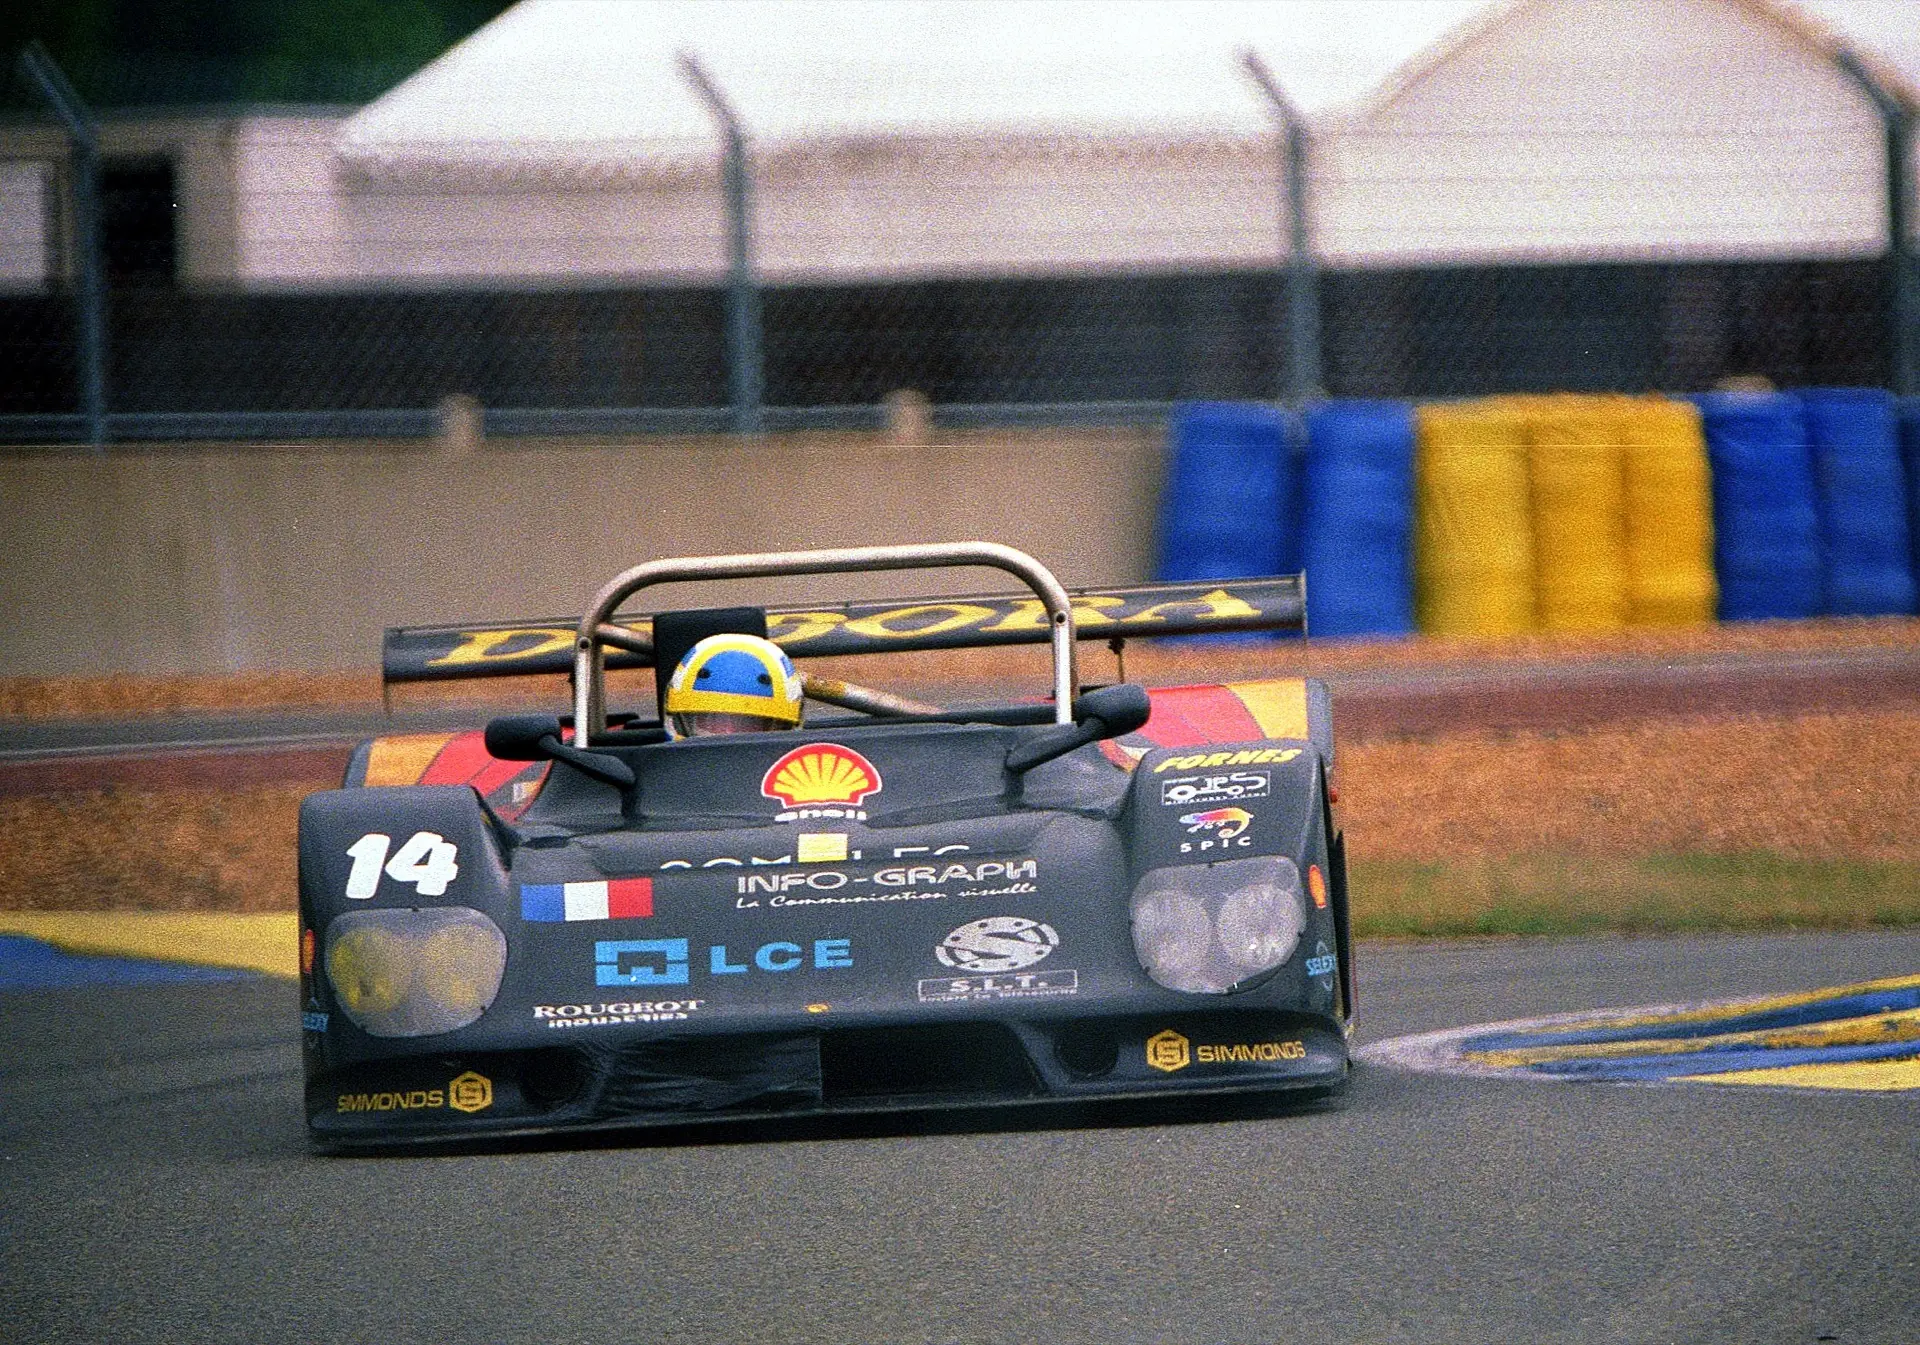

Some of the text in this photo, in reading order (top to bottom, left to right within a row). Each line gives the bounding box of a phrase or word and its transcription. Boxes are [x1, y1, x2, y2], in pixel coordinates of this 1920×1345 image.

[1153, 748, 1303, 773] FORNES
[1180, 836, 1251, 853] SPIC
[345, 831, 459, 900] 14
[737, 860, 1037, 894] INFO-GRAPH
[736, 897, 760, 909] La
[710, 939, 853, 974] LCE
[532, 1000, 705, 1018] ROUGEOT
[1197, 1041, 1306, 1062] SIMMONDS
[336, 1090, 444, 1113] SIMMONDS
